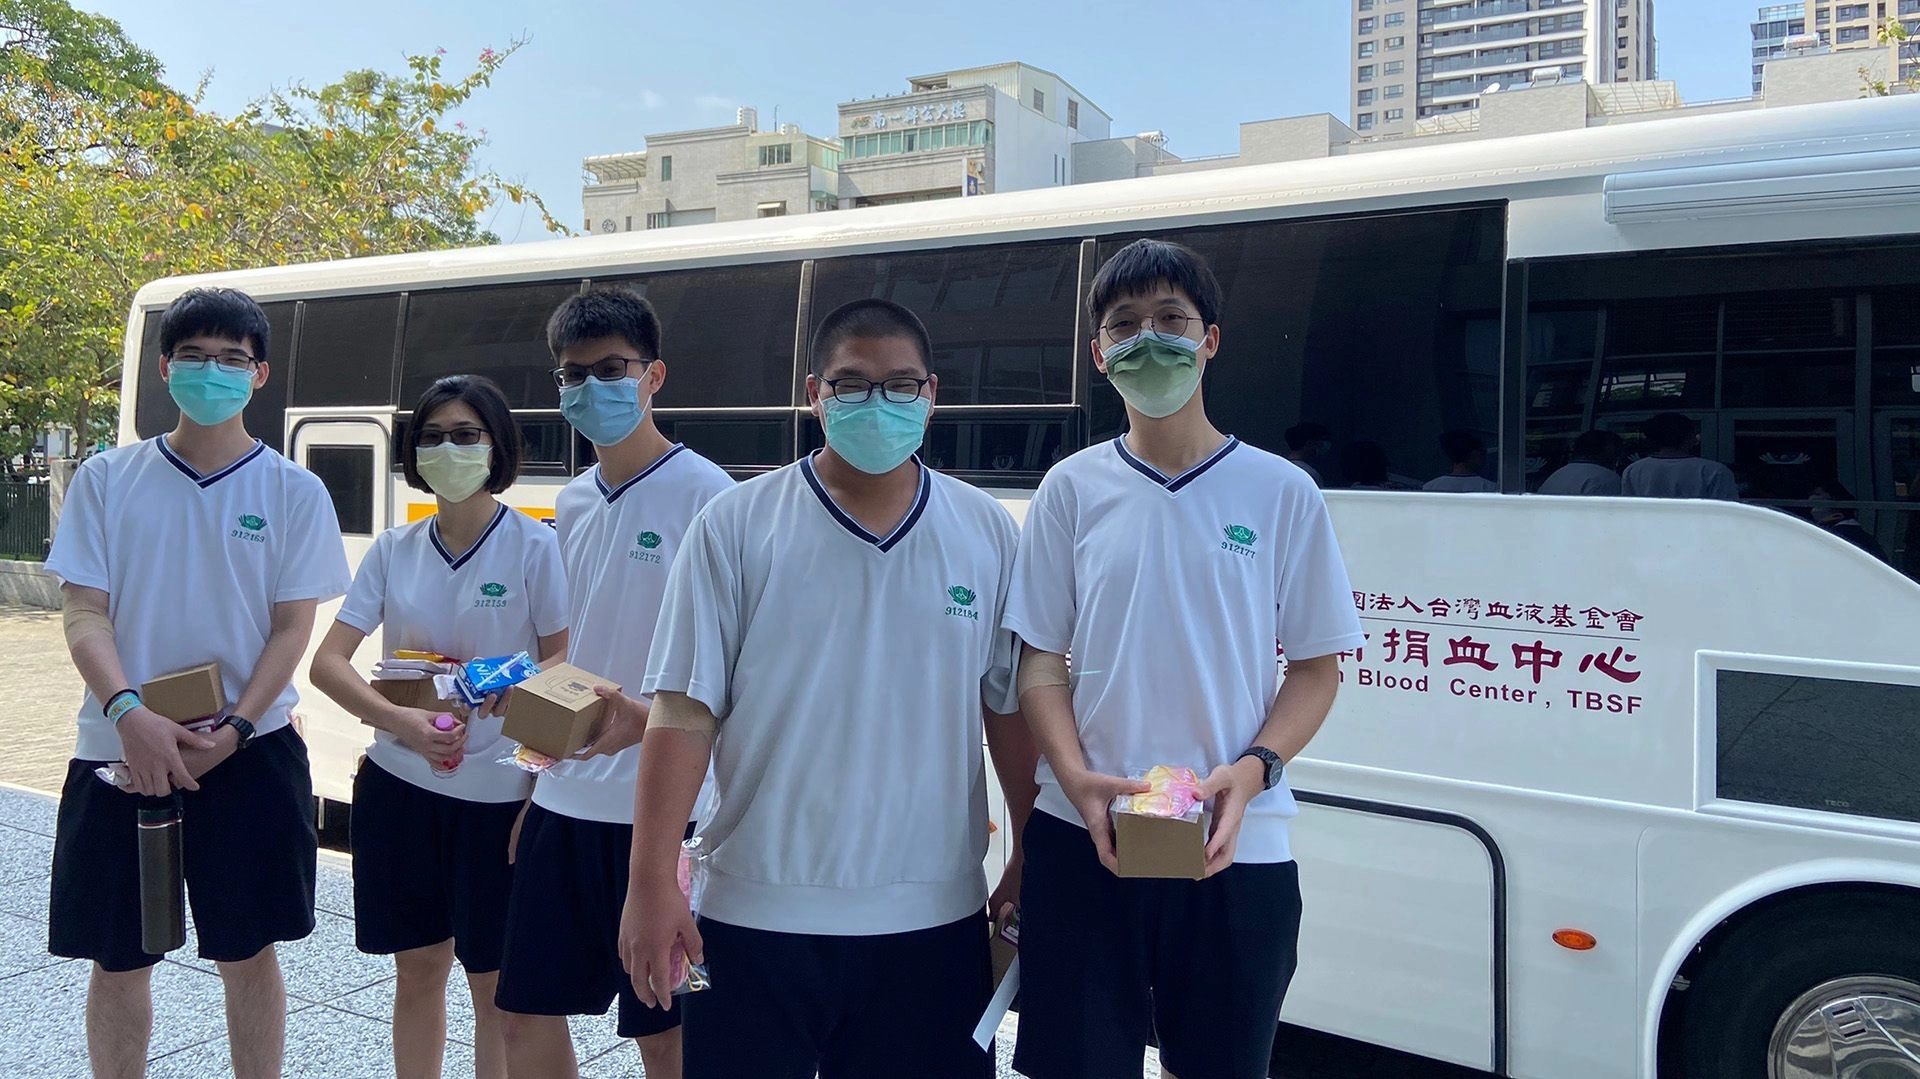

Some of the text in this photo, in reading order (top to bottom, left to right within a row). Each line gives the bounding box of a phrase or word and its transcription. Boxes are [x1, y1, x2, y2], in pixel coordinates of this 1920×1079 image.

[629, 550, 661, 564] 912172
[1221, 541, 1256, 559] 912177
[945, 606, 979, 621] 912184
[1358, 668, 1429, 692] Blood
[1450, 678, 1551, 709] Center,
[1567, 690, 1643, 715] TBSF
[1824, 799, 1850, 808] TECO
